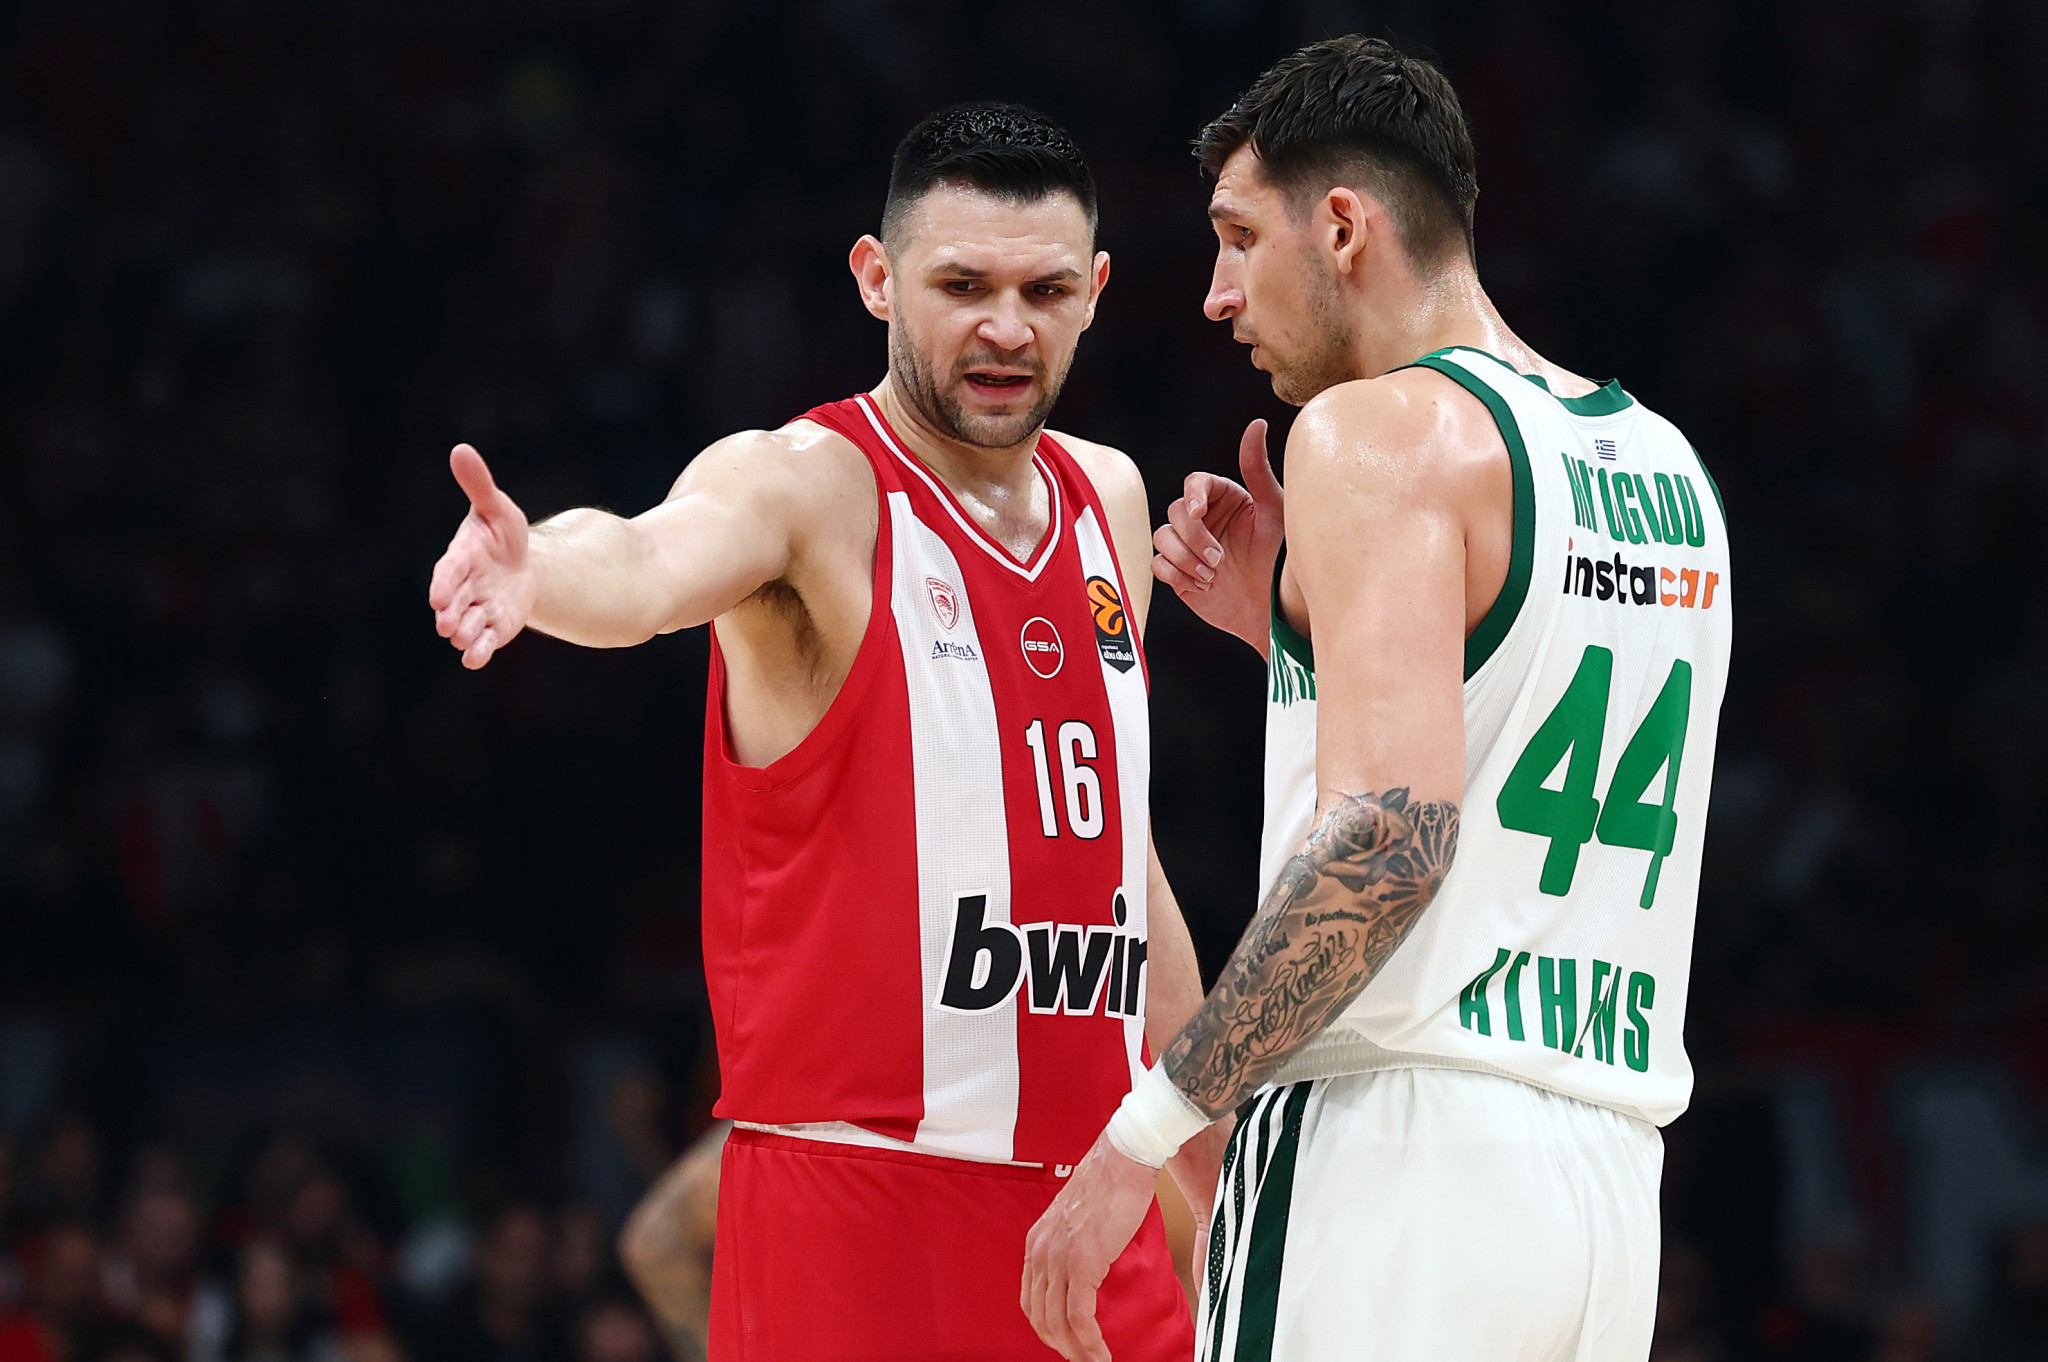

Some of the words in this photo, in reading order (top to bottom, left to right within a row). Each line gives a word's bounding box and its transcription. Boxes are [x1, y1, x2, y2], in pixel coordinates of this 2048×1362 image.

[1563, 536, 1720, 610] instacar
[1024, 640, 1061, 654] GSA
[1025, 718, 1105, 840] 16
[1496, 644, 1692, 910] 44
[1459, 947, 1656, 1073] ATHENS
